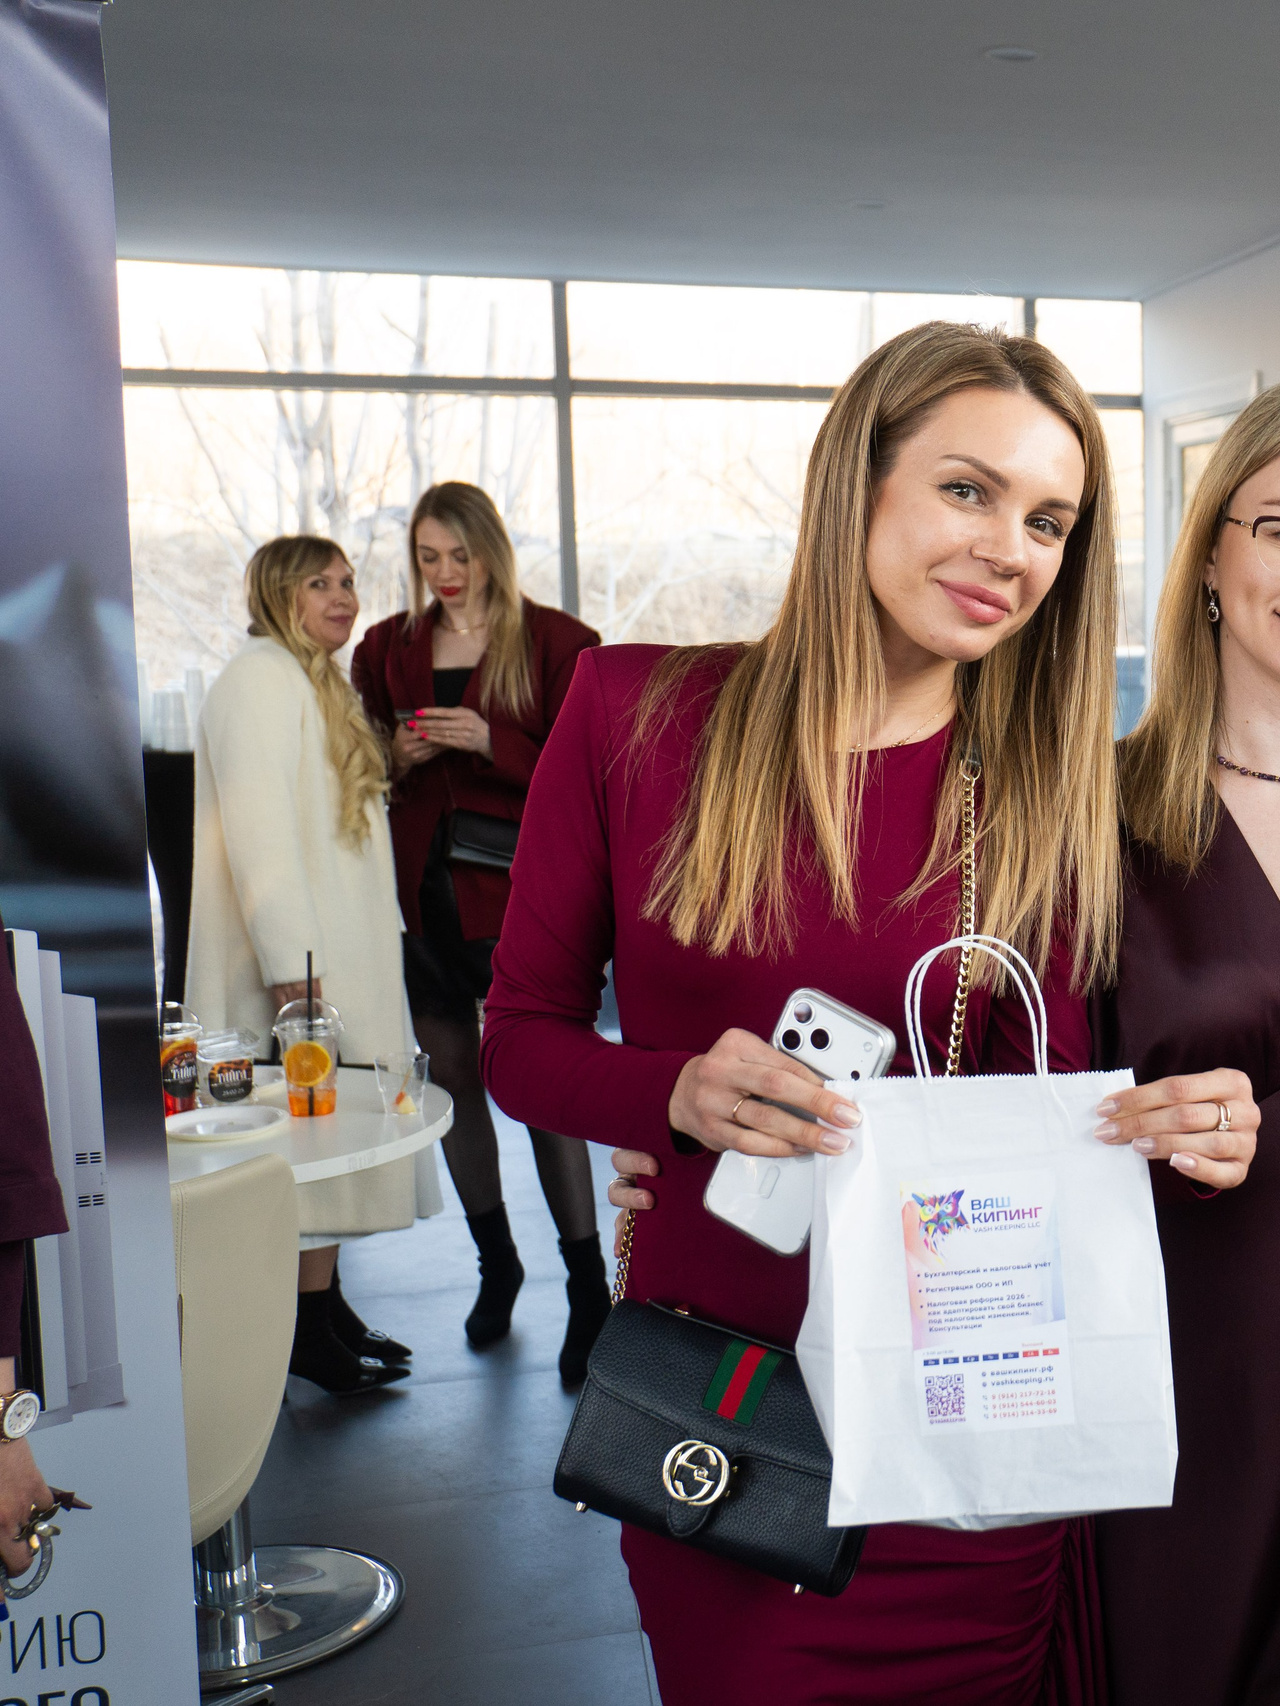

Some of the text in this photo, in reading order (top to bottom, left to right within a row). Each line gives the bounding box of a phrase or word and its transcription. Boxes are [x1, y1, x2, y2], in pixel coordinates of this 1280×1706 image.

[970, 1196, 1011, 1210] ВАШ
[971, 1206, 1043, 1224] КИПИНГ
[995, 1222, 1026, 1231] KEEPING
[924, 1266, 981, 1279] Бухгалтерский
[989, 1262, 1032, 1272] налоговый
[1034, 1261, 1051, 1270] учёт
[925, 1283, 974, 1293] Регистрация
[975, 1281, 993, 1289] ООО
[1001, 1279, 1013, 1287] ИП
[926, 1299, 968, 1308] Налоговая
[969, 1295, 1004, 1305] реформа
[1006, 1293, 1025, 1301] 2026
[943, 1306, 996, 1315] адаптировать
[997, 1302, 1016, 1310] свой
[1017, 1300, 1044, 1308] бизнес
[928, 1317, 943, 1325] под
[944, 1314, 986, 1323] налоговые
[928, 1322, 983, 1333] Консультации
[990, 1365, 1054, 1377] вашкипинг.рф
[0, 1610, 106, 1674] ИЮ
